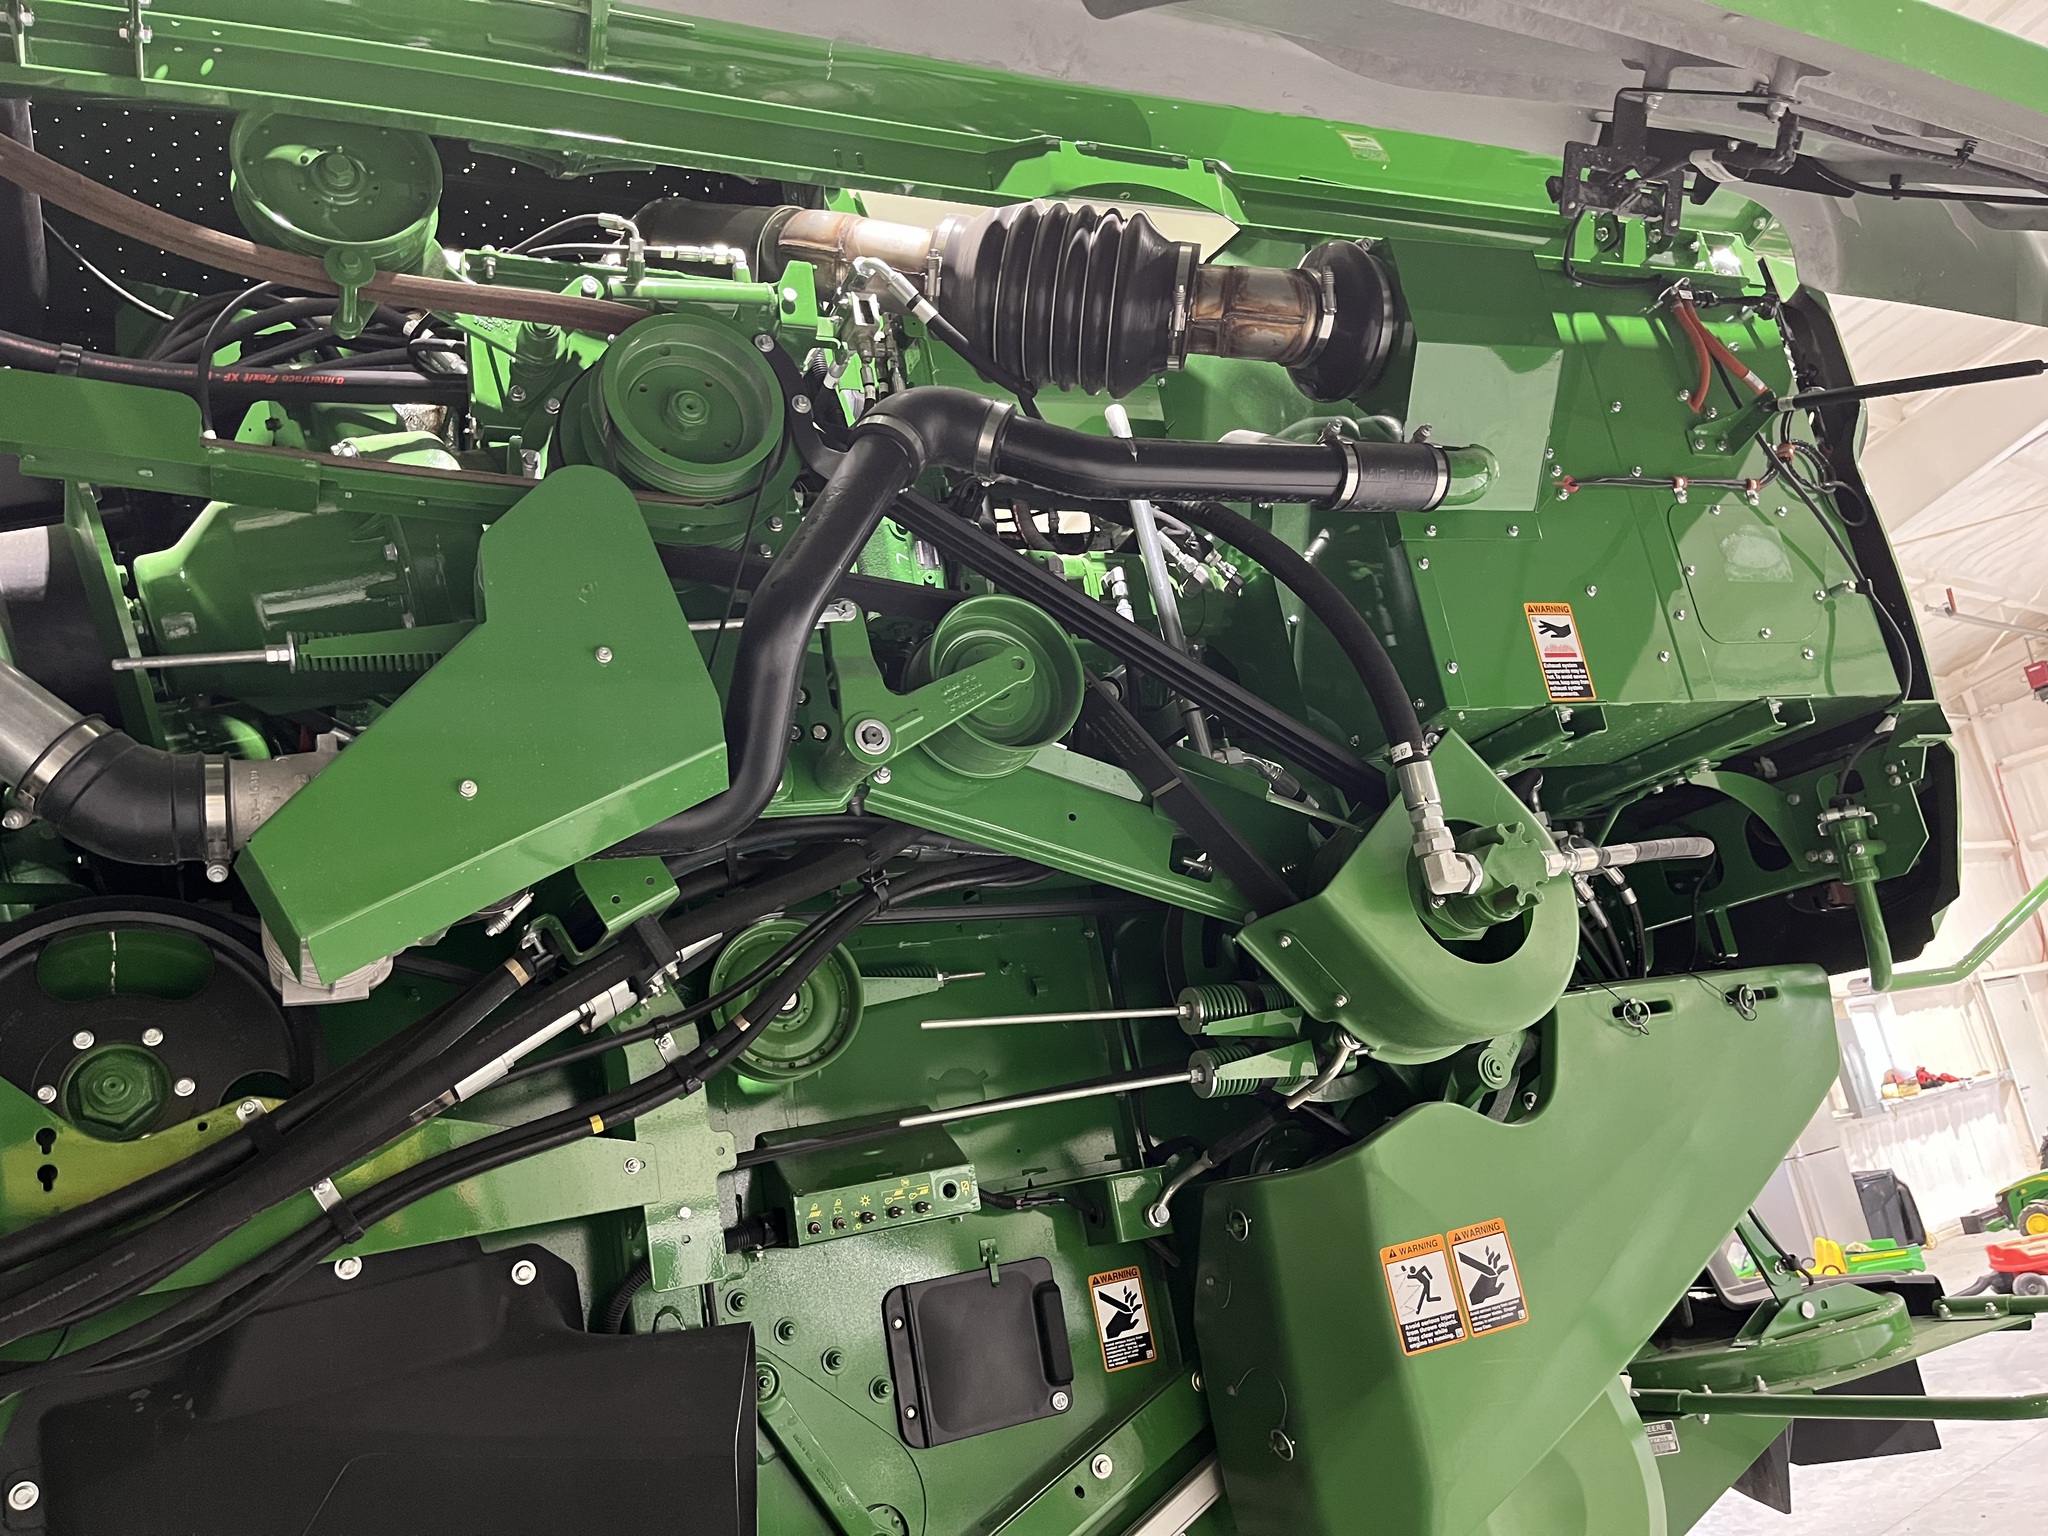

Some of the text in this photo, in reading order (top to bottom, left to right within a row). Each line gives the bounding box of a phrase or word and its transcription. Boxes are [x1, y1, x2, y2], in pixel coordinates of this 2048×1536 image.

[1398, 469, 1434, 481] FLOW
[1533, 605, 1570, 613] WARNING
[1461, 1222, 1501, 1240] WARNING
[1398, 1239, 1439, 1256] WARNING
[1099, 1268, 1138, 1283] WARNING
[1405, 1313, 1456, 1330] Avoid serious injury
[1406, 1319, 1459, 1337] from thrown objects.
[1409, 1340, 1428, 1349] engine
[1433, 1333, 1455, 1342] running.
[1420, 1332, 1434, 1340] clear
[1433, 1328, 1449, 1336] while
